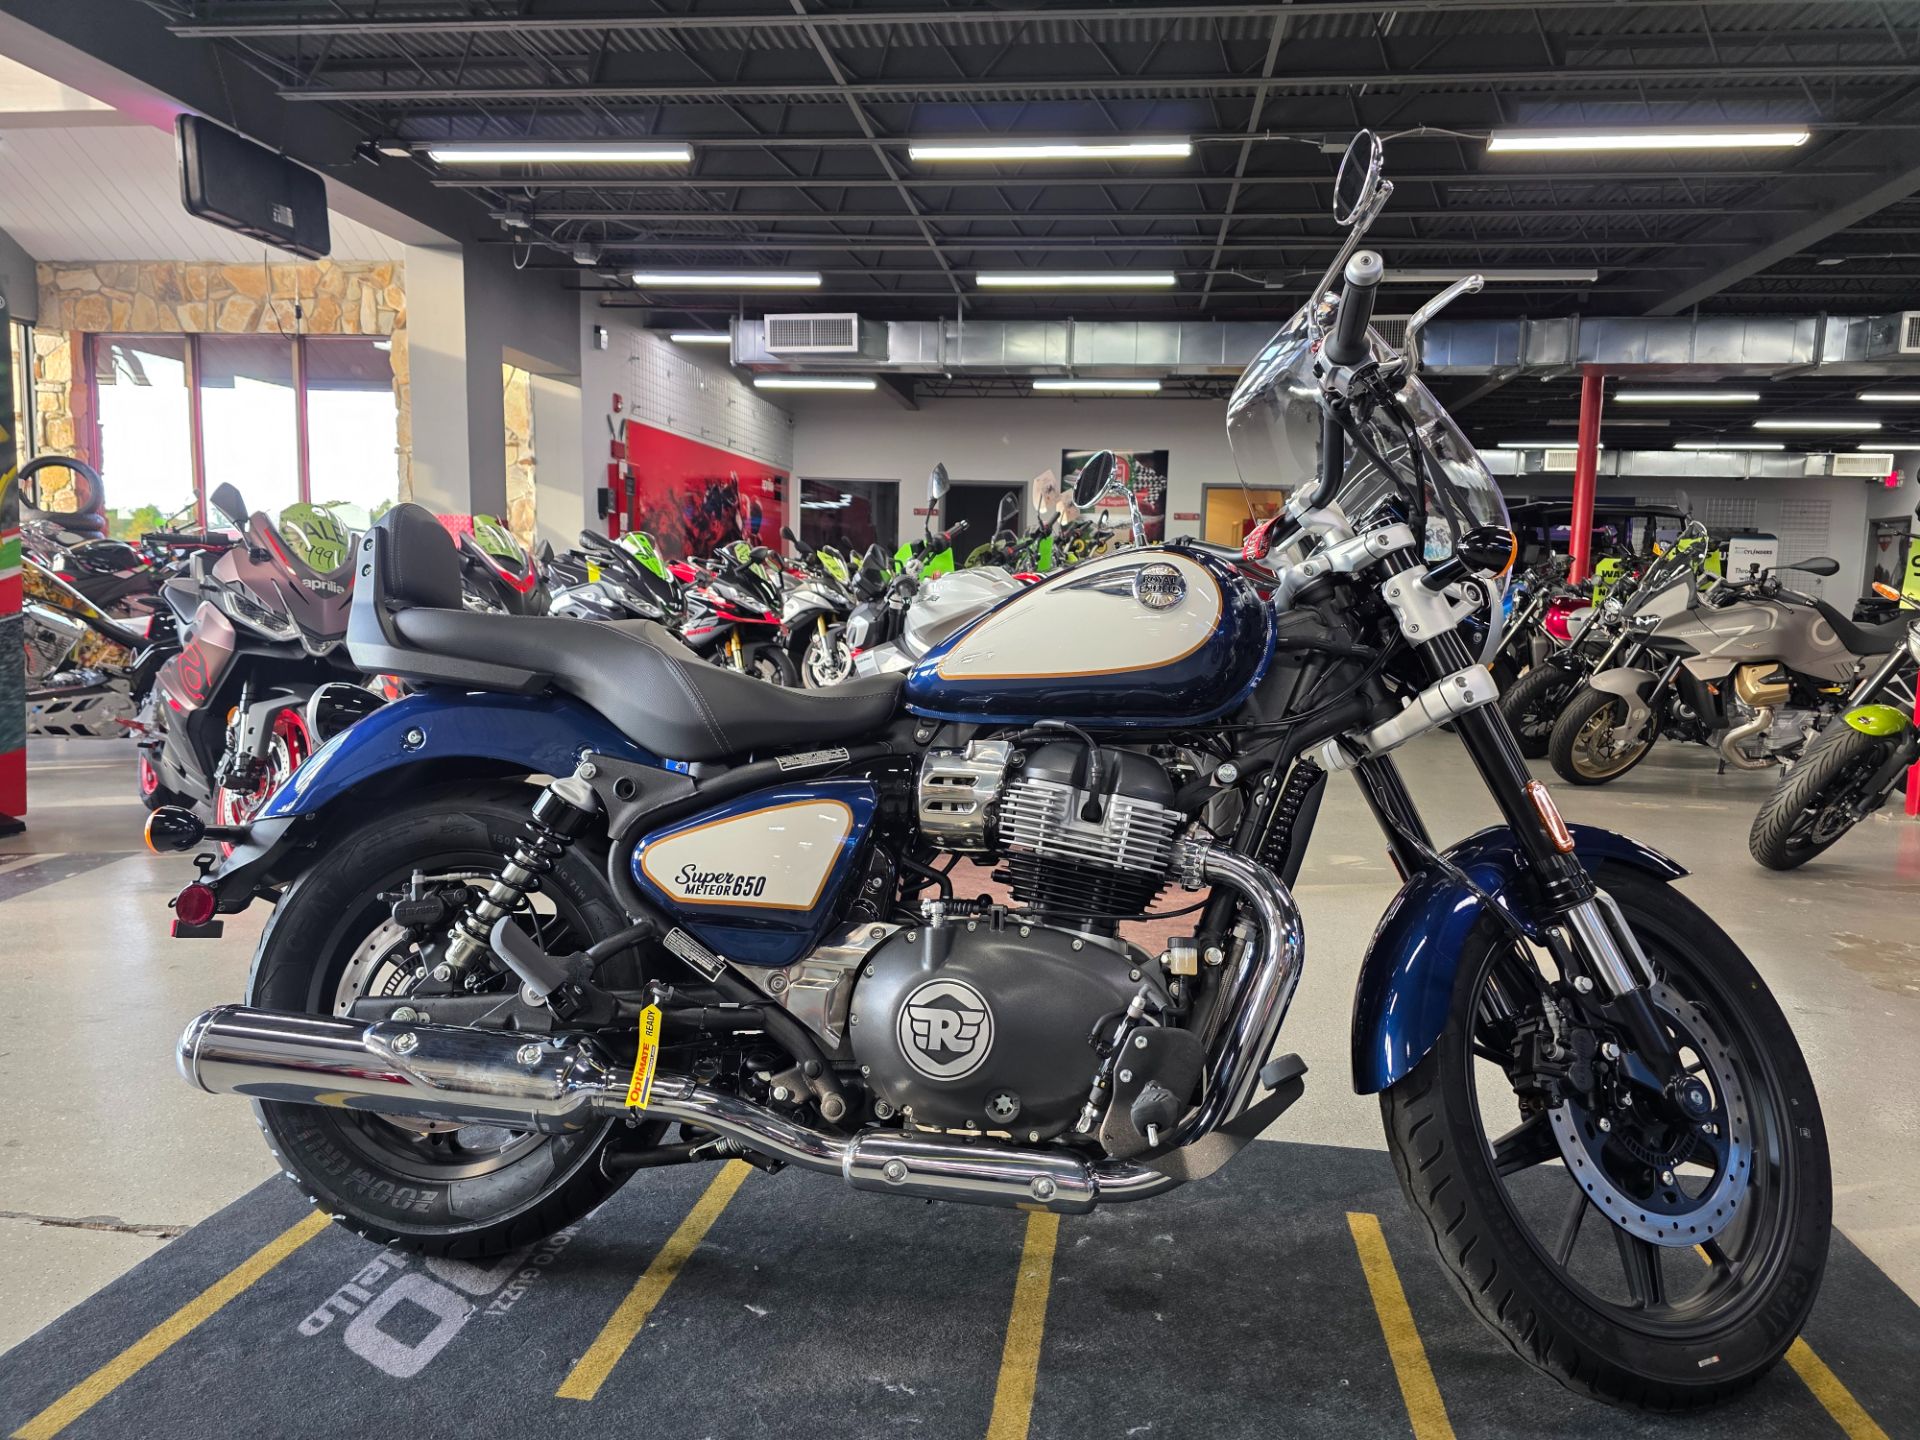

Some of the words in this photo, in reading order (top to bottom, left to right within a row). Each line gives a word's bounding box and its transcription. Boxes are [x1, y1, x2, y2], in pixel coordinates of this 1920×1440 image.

[302, 579, 345, 594] aprilia
[675, 863, 735, 889] Super
[684, 883, 731, 896] METEOR
[732, 875, 767, 897] 650
[646, 1009, 656, 1037] READY
[483, 1266, 541, 1317] GUZZI
